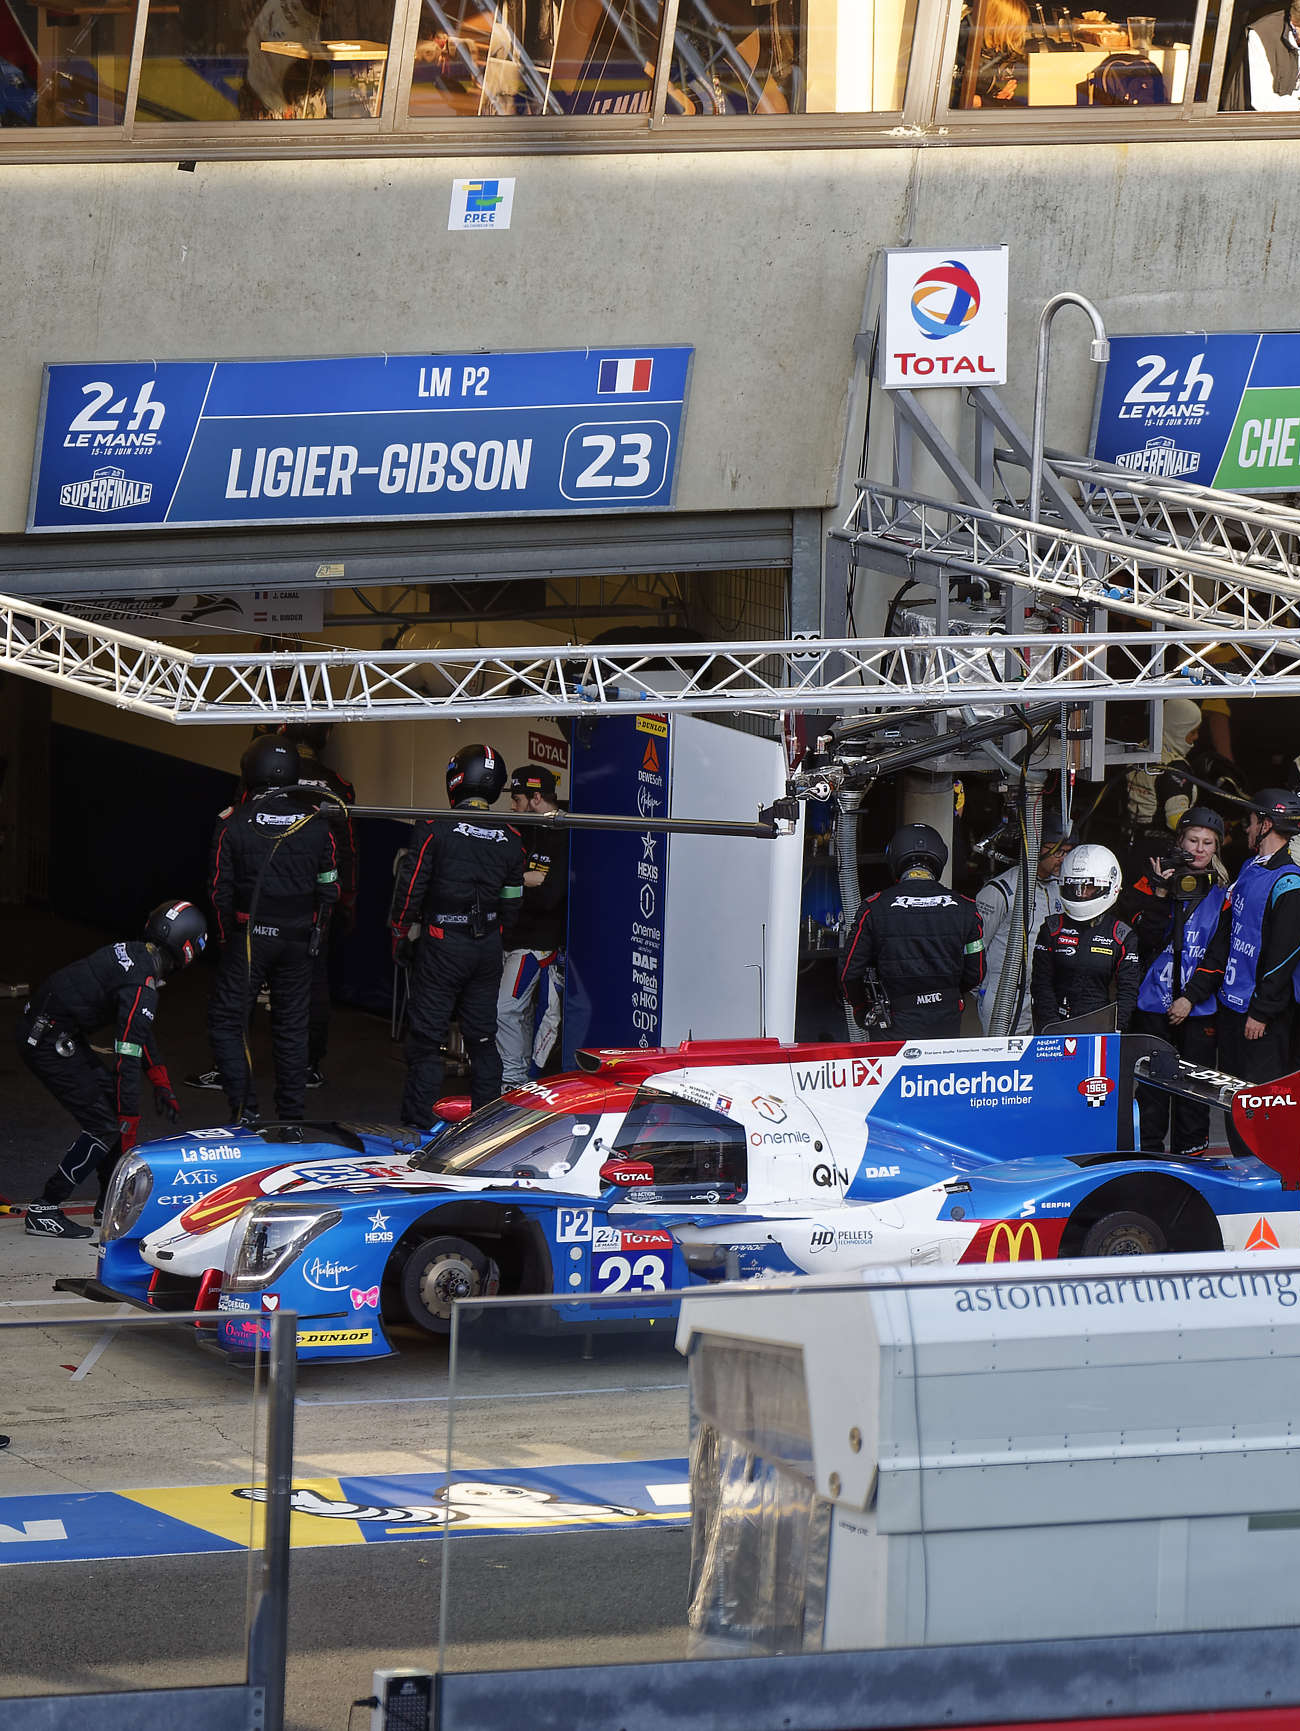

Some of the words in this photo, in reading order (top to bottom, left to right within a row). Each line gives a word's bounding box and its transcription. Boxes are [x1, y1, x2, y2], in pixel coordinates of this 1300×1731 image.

[893, 353, 996, 376] TOTAL
[418, 367, 450, 398] LM
[461, 366, 489, 397] P2
[1123, 353, 1214, 403] 24h
[69, 381, 166, 431] 24h
[1118, 405, 1145, 419] LE
[1147, 404, 1206, 418] MANS
[63, 434, 91, 448] LE
[93, 433, 157, 447] MANS
[91, 448, 112, 456] 15-16
[114, 447, 132, 456] JUIN
[134, 447, 153, 456] 2019
[575, 433, 652, 488] 23
[224, 438, 533, 499] LIGIER-GIBSON
[1117, 446, 1199, 478] SUPERFINALE
[61, 477, 152, 511] SUPERFINALE
[641, 720, 667, 733] DUNLOP
[529, 736, 567, 764] TOTAL
[637, 861, 659, 880] HEXIS
[632, 952, 658, 971] DAF
[640, 991, 658, 1011] HKO
[916, 992, 943, 1005] MRTC
[632, 1009, 658, 1033] GDP
[852, 1058, 883, 1088] FX
[900, 1069, 1034, 1098] binderholz
[1086, 1083, 1107, 1094] 1969
[517, 1081, 562, 1106] OTAL
[970, 1097, 998, 1108] tiptop
[1001, 1095, 1033, 1105] timber
[1237, 1094, 1297, 1109] TOTAL
[181, 1148, 198, 1163] La
[200, 1146, 242, 1161] Sarthe
[171, 1168, 218, 1186] Axis
[613, 1172, 652, 1182] TOTAL
[865, 1166, 901, 1179] DAF
[559, 1210, 589, 1238] P2
[365, 1231, 393, 1241] HEXIS
[595, 1230, 620, 1244] 24h
[623, 1232, 670, 1245] TOTAL
[810, 1231, 835, 1246] HD
[838, 1231, 873, 1240] PELLETS
[597, 1255, 666, 1294] 23
[306, 1332, 369, 1342] DUNLOP
